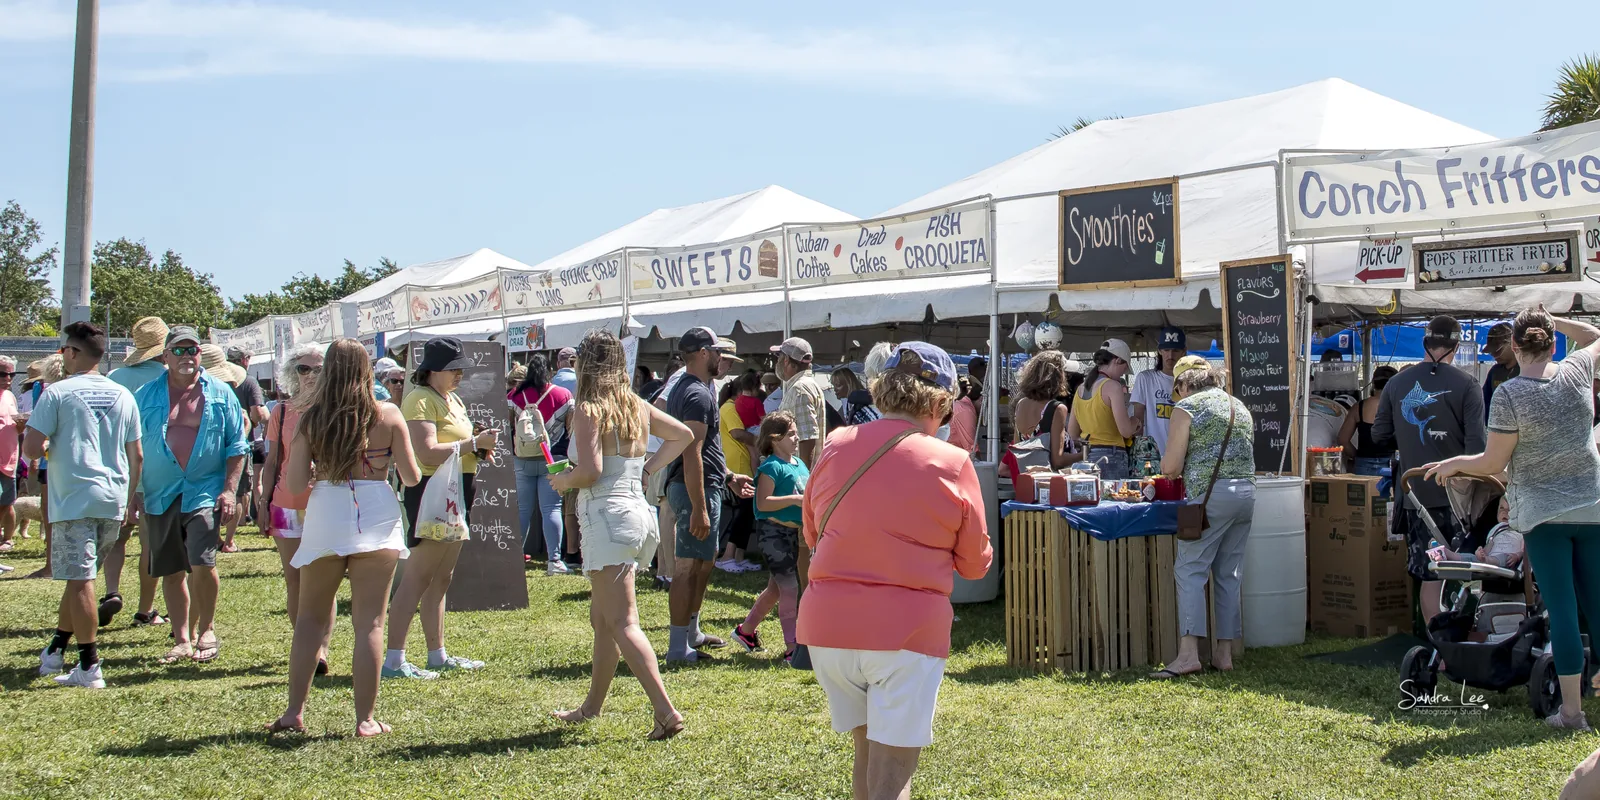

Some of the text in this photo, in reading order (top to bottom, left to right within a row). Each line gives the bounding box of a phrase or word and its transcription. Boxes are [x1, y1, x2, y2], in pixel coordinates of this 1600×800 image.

[1299, 153, 1600, 219] Conch Fritters
[925, 211, 961, 240] FISH
[1068, 204, 1155, 265] Smoothies
[795, 232, 829, 254] Cuban
[857, 224, 887, 249] Crab
[850, 250, 888, 275] Cakes
[904, 237, 987, 271] CROQUETA
[1360, 245, 1403, 267] PICK-UP
[1426, 244, 1565, 267] POPS FRITTER FRYER
[559, 258, 619, 287] STONE CRAB
[651, 245, 752, 290] SWEETS
[797, 256, 831, 280] Coffee
[432, 289, 488, 317] SHRIMP
[536, 287, 564, 307] CLAMS
[1237, 310, 1282, 327] Strawberry
[508, 325, 526, 337] STONE
[509, 336, 524, 347] CRAB
[1164, 332, 1179, 343] M
[1257, 331, 1280, 345] Colada
[1459, 329, 1479, 342] RST
[1239, 348, 1269, 364] Mango
[1241, 384, 1261, 397] Oreo
[467, 403, 496, 419] offee
[1156, 403, 1173, 418] 20
[1247, 401, 1278, 413] emonade
[472, 489, 499, 508] ake
